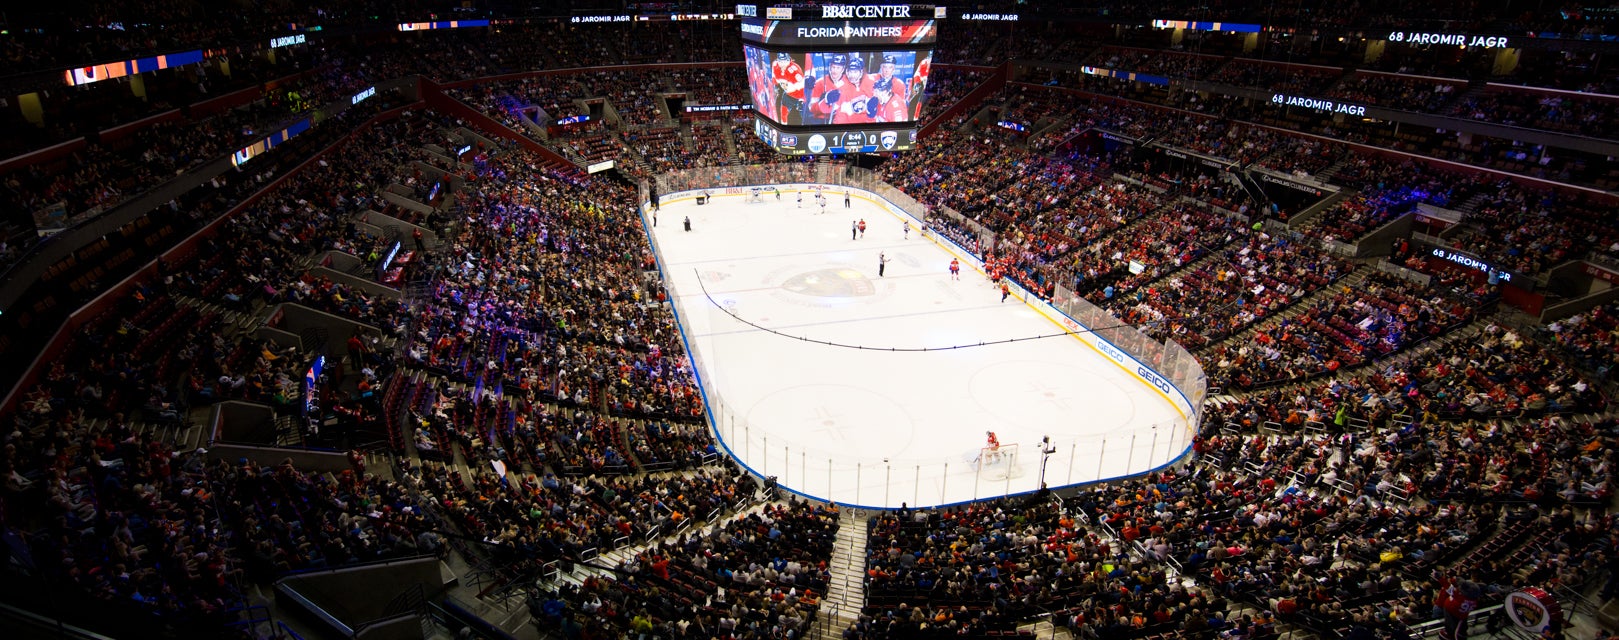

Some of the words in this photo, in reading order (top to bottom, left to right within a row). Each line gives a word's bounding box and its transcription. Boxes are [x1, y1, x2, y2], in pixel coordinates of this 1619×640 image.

[822, 5, 855, 18] BB&T
[856, 5, 910, 18] CENTER
[797, 27, 845, 38] FLORIDA
[847, 26, 902, 37] PANTHERS
[1388, 31, 1404, 41] 68
[1406, 32, 1466, 46] JAROMIR
[1468, 36, 1508, 48] JAGR
[1272, 94, 1284, 103] 68
[1285, 96, 1333, 111] JAROMIR
[1334, 103, 1365, 116] JAGR
[832, 135, 838, 146] 1
[870, 134, 876, 145] 0
[1432, 248, 1445, 257] 68
[1097, 341, 1124, 363] GEICO
[1137, 366, 1170, 394] GEICO
